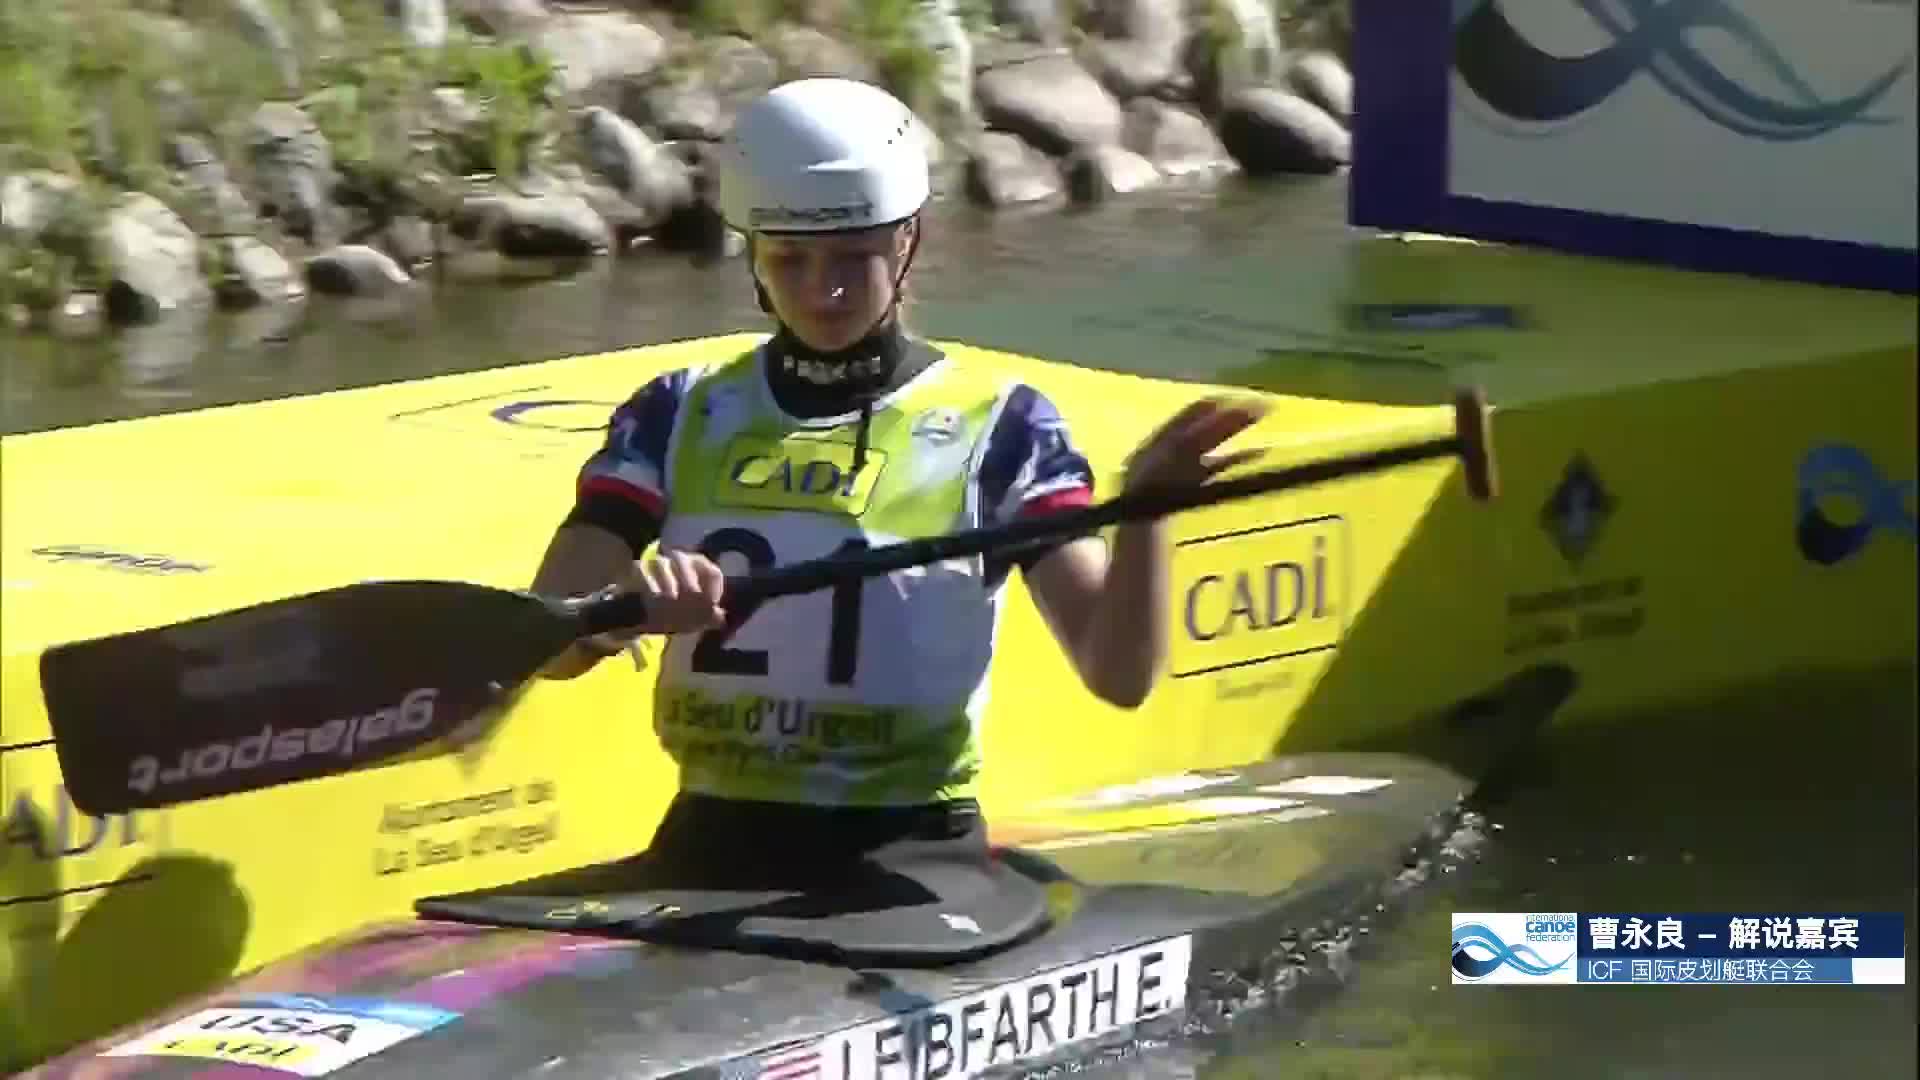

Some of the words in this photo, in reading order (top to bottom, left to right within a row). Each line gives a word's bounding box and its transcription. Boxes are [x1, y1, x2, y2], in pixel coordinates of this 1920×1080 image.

[691, 526, 872, 686] 21
[127, 686, 440, 793] galasport
[1136, 951, 1171, 1019] E.
[199, 1012, 358, 1046] USA
